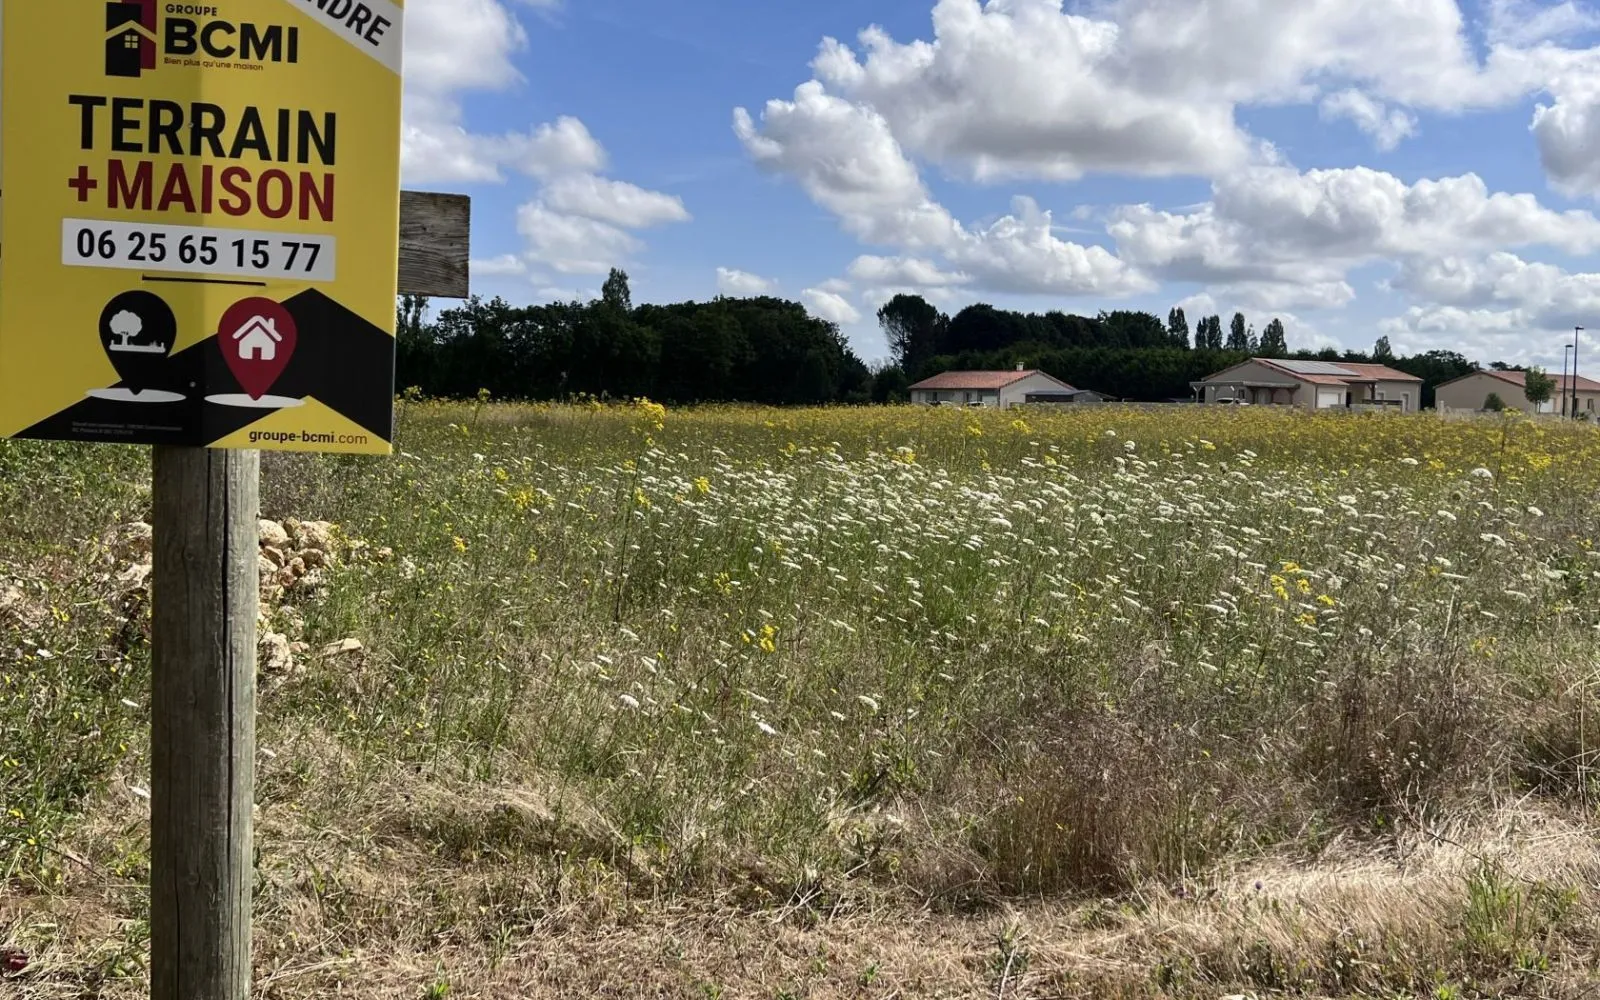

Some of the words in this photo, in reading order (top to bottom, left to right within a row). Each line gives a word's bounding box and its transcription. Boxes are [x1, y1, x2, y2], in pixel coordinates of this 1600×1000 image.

[165, 4, 218, 16] GROUPE
[164, 17, 299, 63] BCMI
[164, 57, 182, 65] Bien
[184, 58, 201, 67] plus
[203, 60, 231, 69] qu'une
[233, 63, 264, 71] maison
[68, 94, 336, 166] TERRAIN
[77, 228, 116, 259] 06
[127, 231, 167, 262] 25
[178, 235, 218, 265] 65
[231, 238, 269, 269] 15
[281, 241, 321, 272] 77
[249, 430, 368, 445] groupe-bcmi.com
